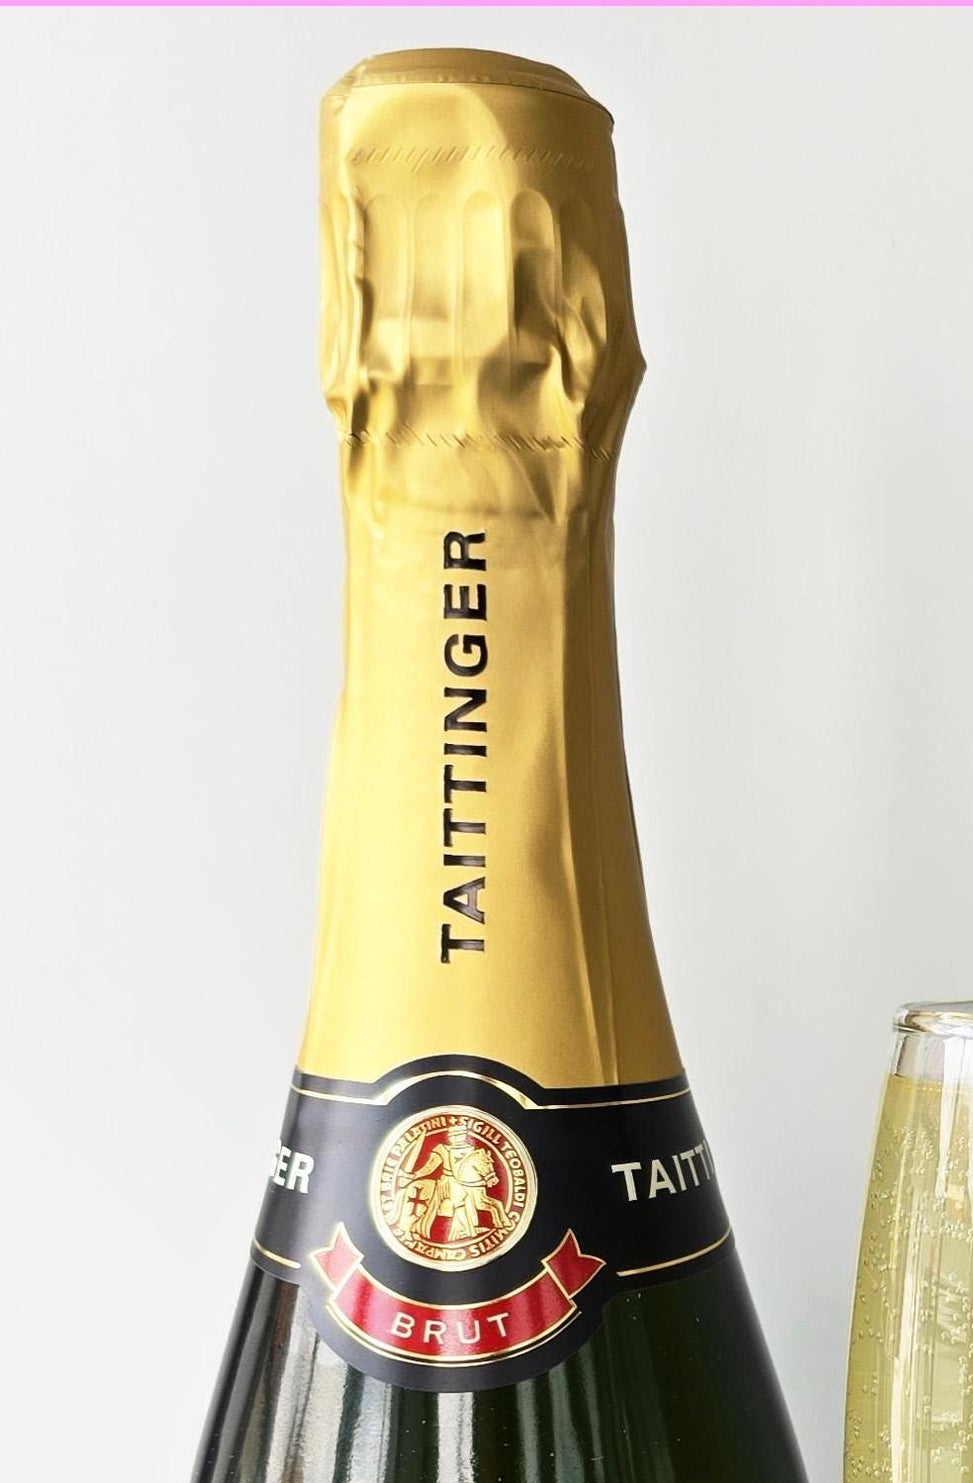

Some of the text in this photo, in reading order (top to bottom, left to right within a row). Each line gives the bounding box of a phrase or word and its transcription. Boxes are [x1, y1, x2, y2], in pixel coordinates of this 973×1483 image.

[440, 529, 489, 964] TAITTINGER
[501, 1141, 527, 1208] TEOBALDI
[390, 1311, 509, 1344] BRUT
